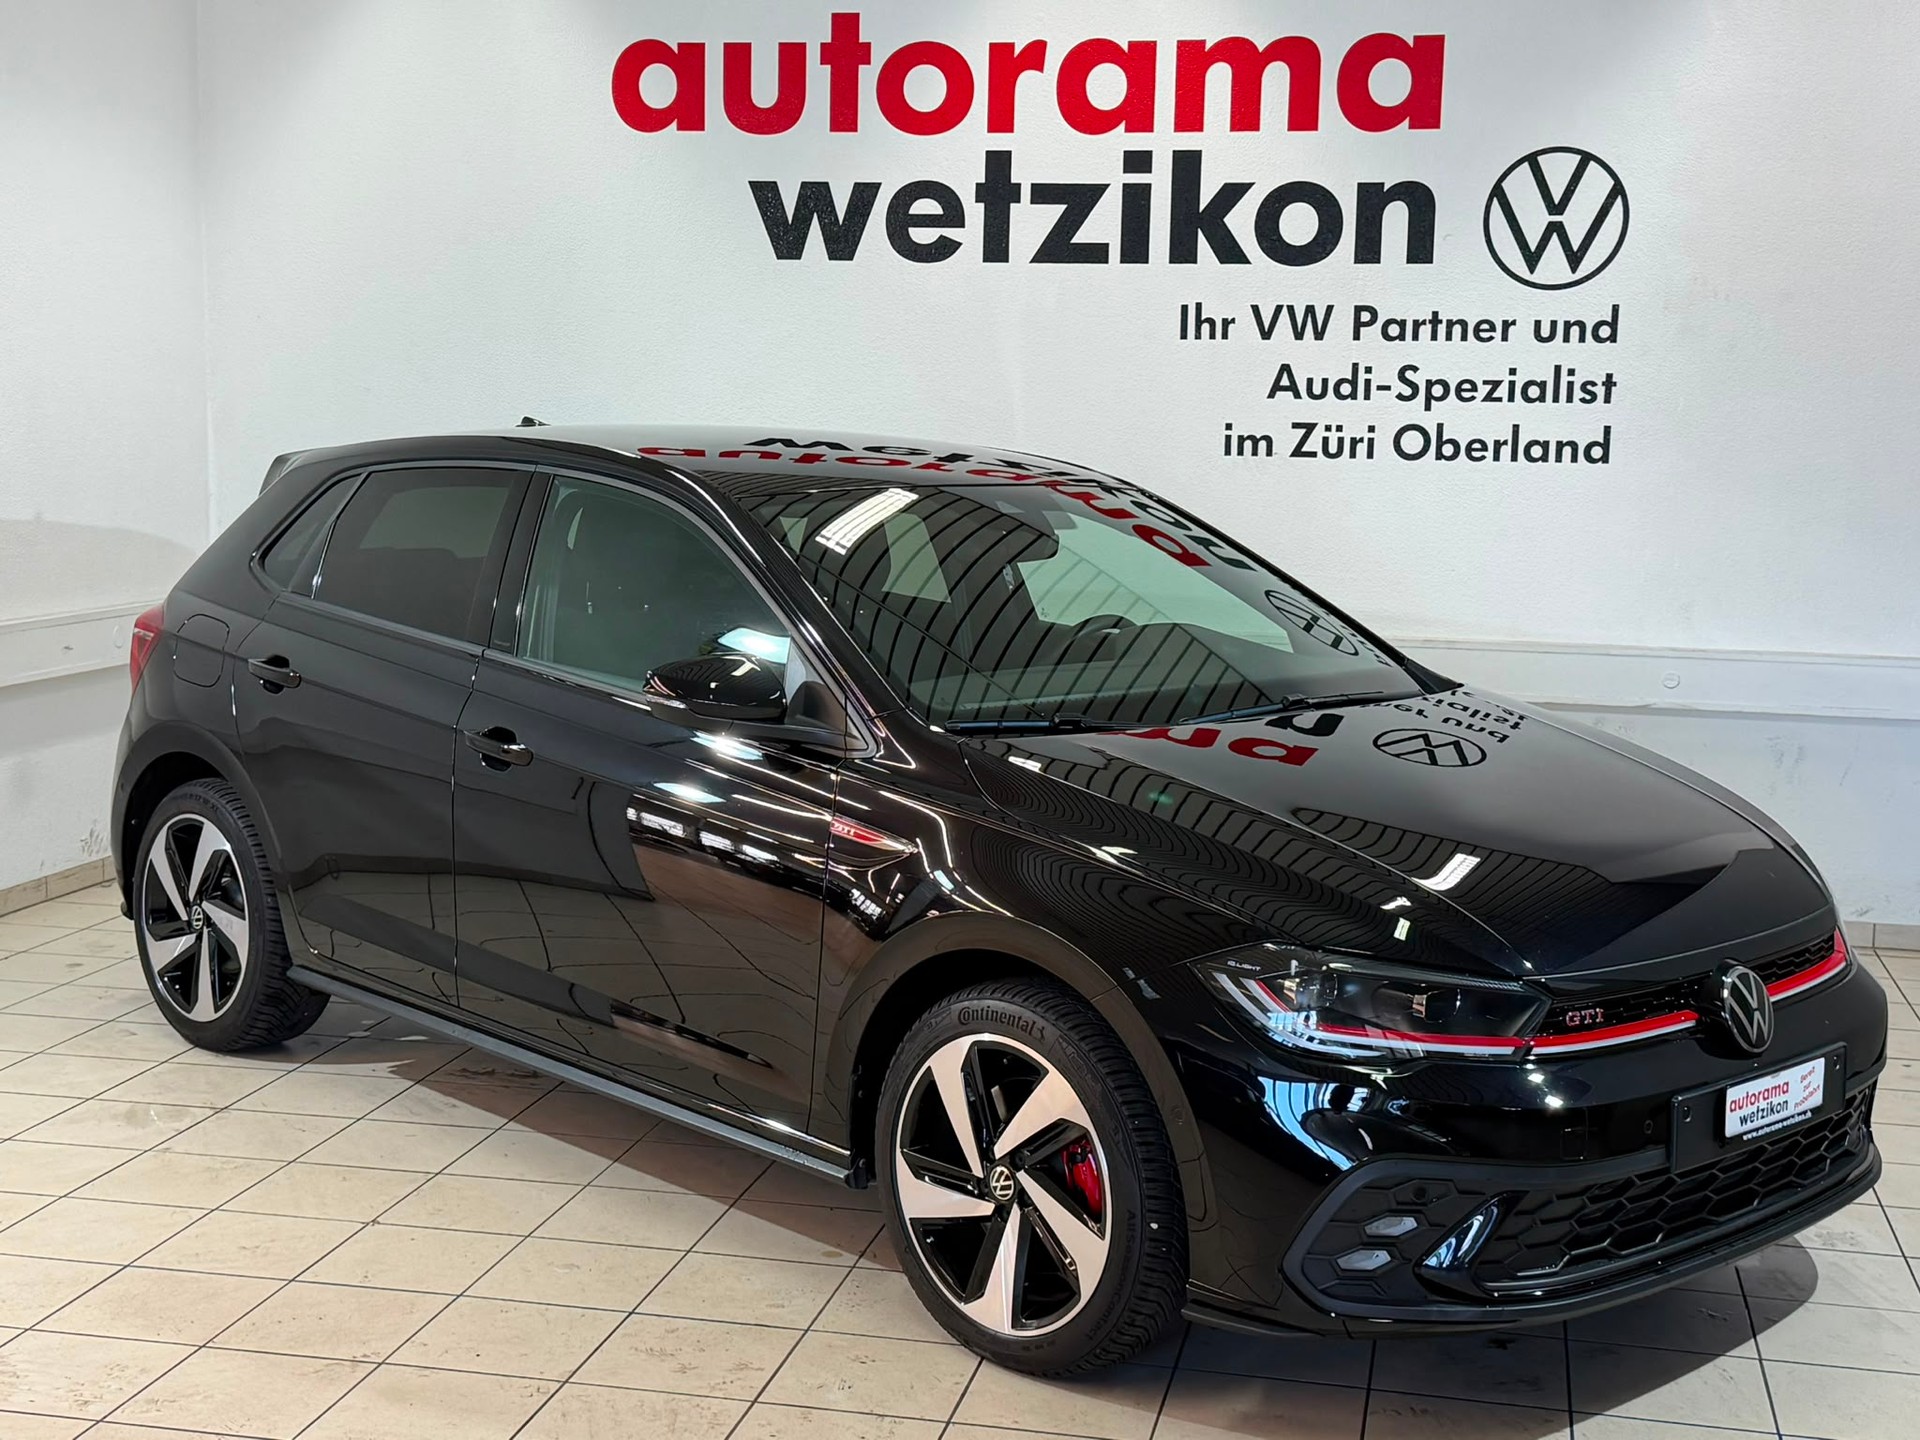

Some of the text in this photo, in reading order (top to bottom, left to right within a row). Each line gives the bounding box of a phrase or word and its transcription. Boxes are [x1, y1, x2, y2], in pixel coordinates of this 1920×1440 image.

[612, 13, 1445, 135] autorama
[748, 150, 1435, 266] wetzikon
[1180, 302, 1619, 343] Ihr VW Partner und
[1267, 363, 1616, 410] Audi-Spezialist
[1225, 423, 1611, 464] im Züri Oberland
[957, 1006, 1036, 1037] Continental
[1566, 1008, 1604, 1026] GTI
[1729, 1081, 1790, 1113] autorama
[1738, 1099, 1789, 1127] wetzikon
